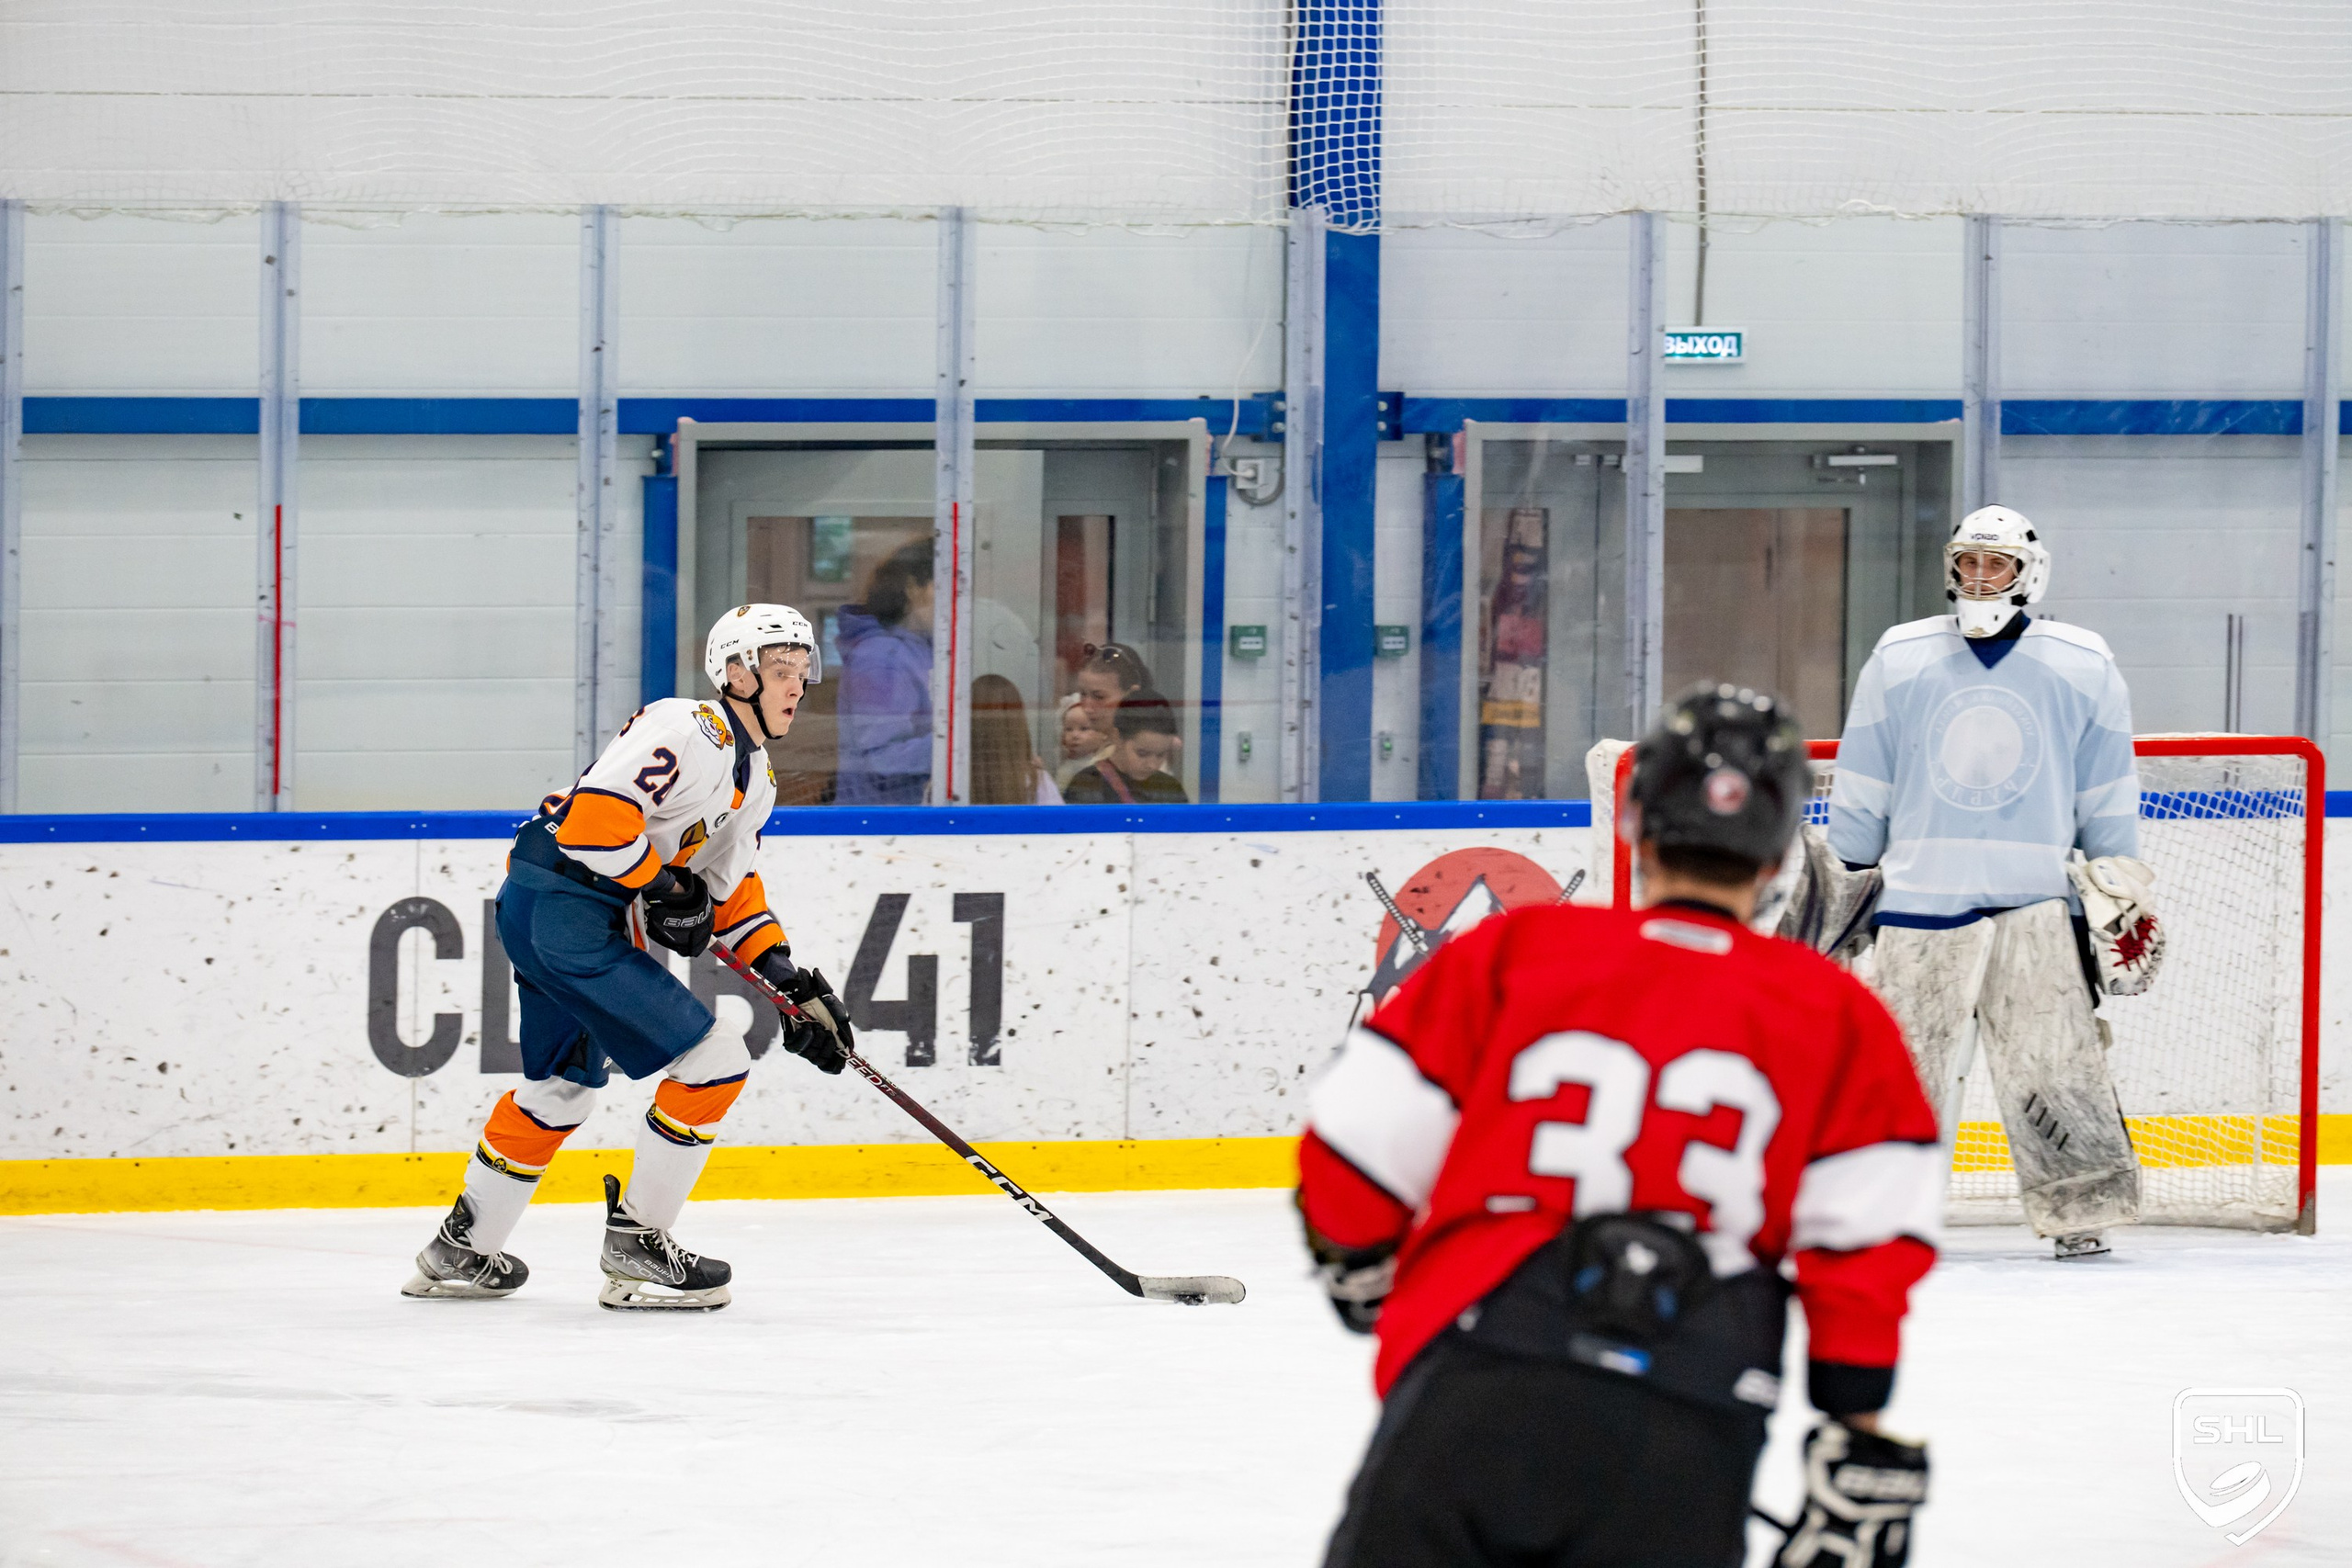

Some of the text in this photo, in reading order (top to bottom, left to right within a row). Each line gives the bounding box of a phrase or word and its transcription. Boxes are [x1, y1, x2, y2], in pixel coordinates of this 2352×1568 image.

[1664, 335, 1738, 356] ВЫХОД
[720, 638, 740, 649] CCM
[368, 892, 1005, 1077] CLB 41
[1507, 1029, 1784, 1279] 33
[966, 1155, 1054, 1222] CCM
